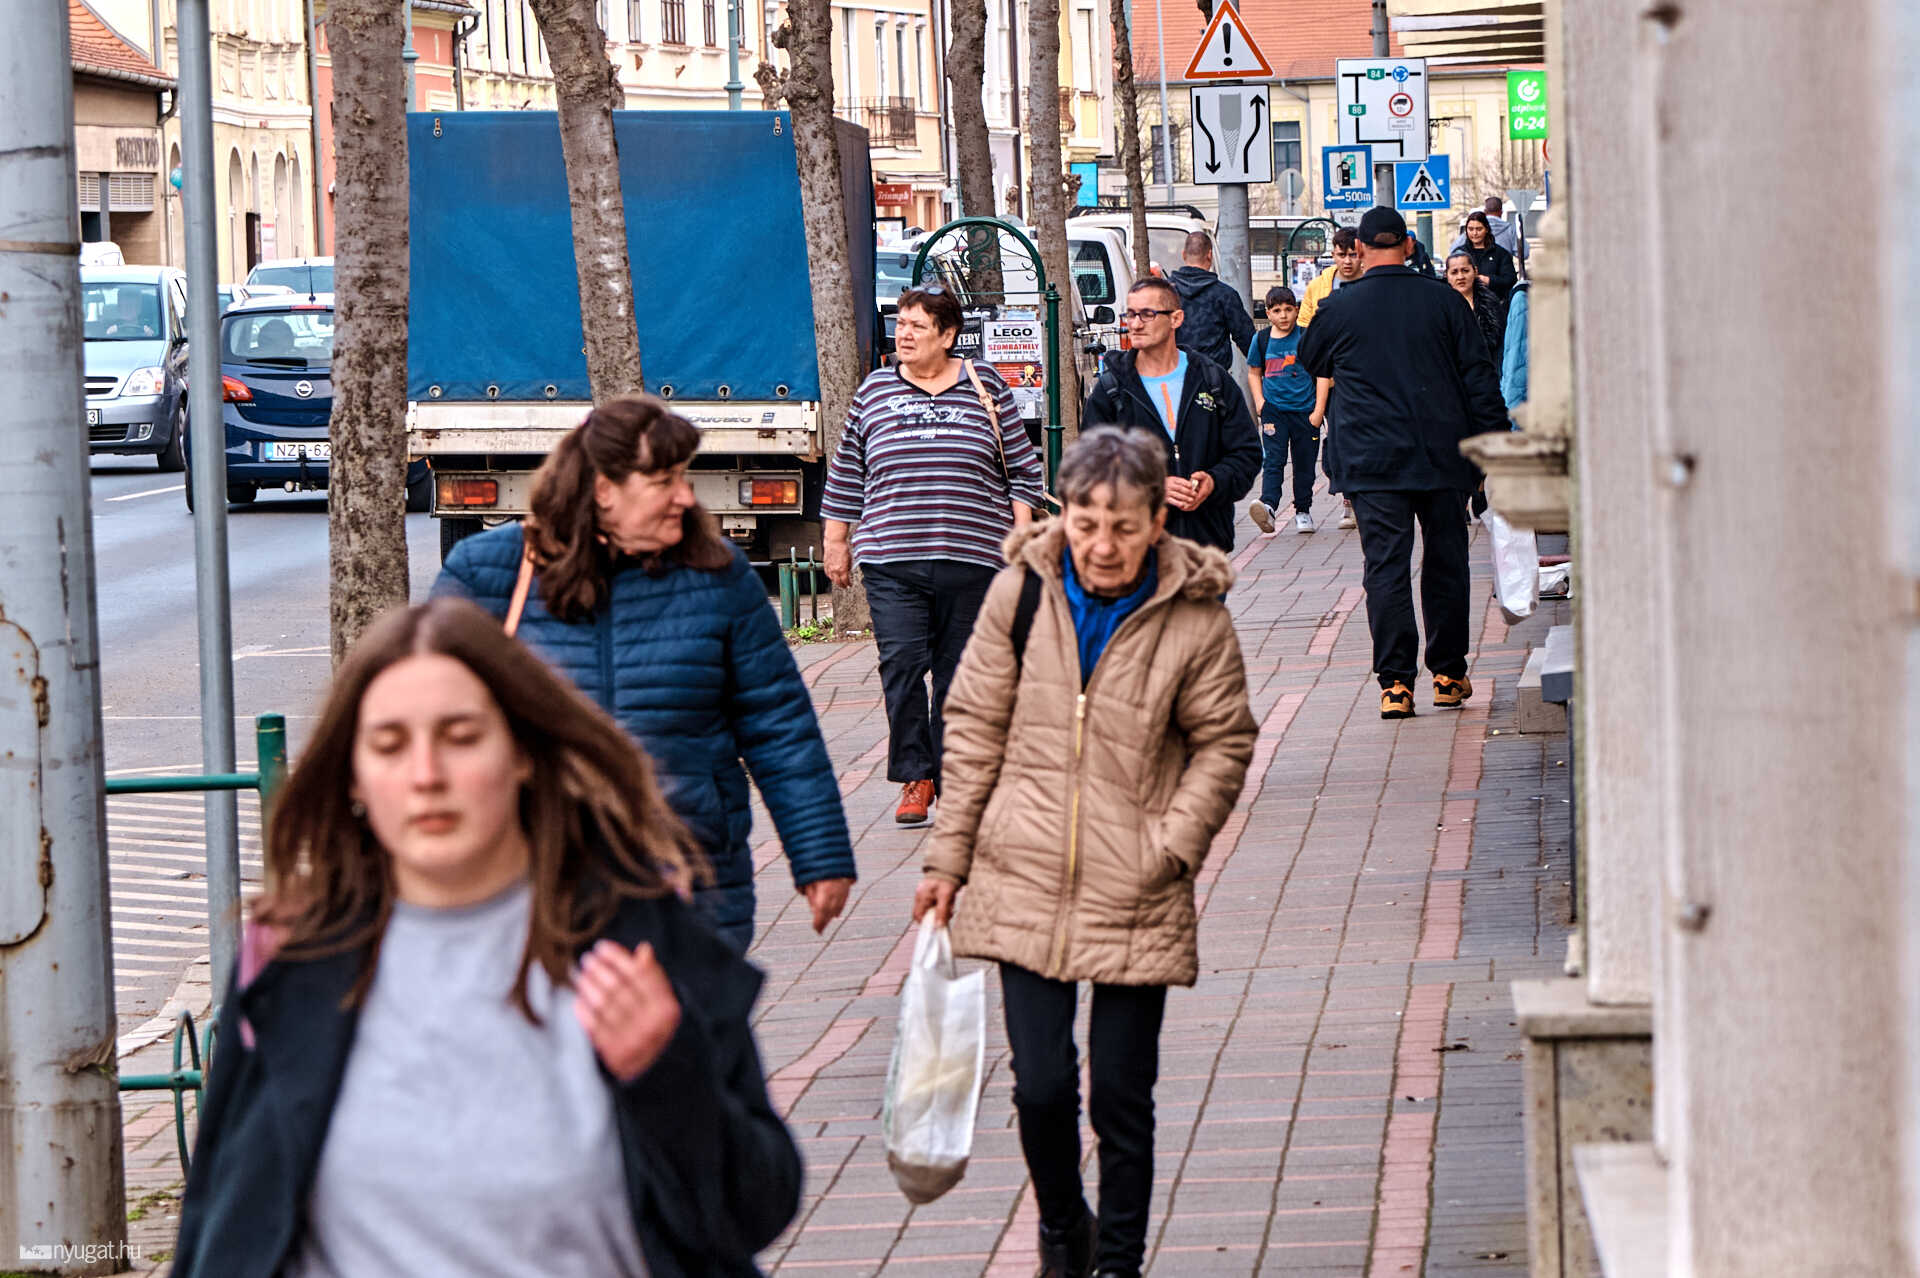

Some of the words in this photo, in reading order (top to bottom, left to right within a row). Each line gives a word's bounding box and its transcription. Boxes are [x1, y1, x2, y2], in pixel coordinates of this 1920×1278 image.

[1370, 69, 1381, 78] 84
[1513, 116, 1545, 131] 0-24
[877, 190, 910, 202] Triumph
[1344, 191, 1372, 203] 500m
[1340, 214, 1357, 224] MOL
[993, 328, 1033, 337] LEGO
[88, 411, 96, 423] 3
